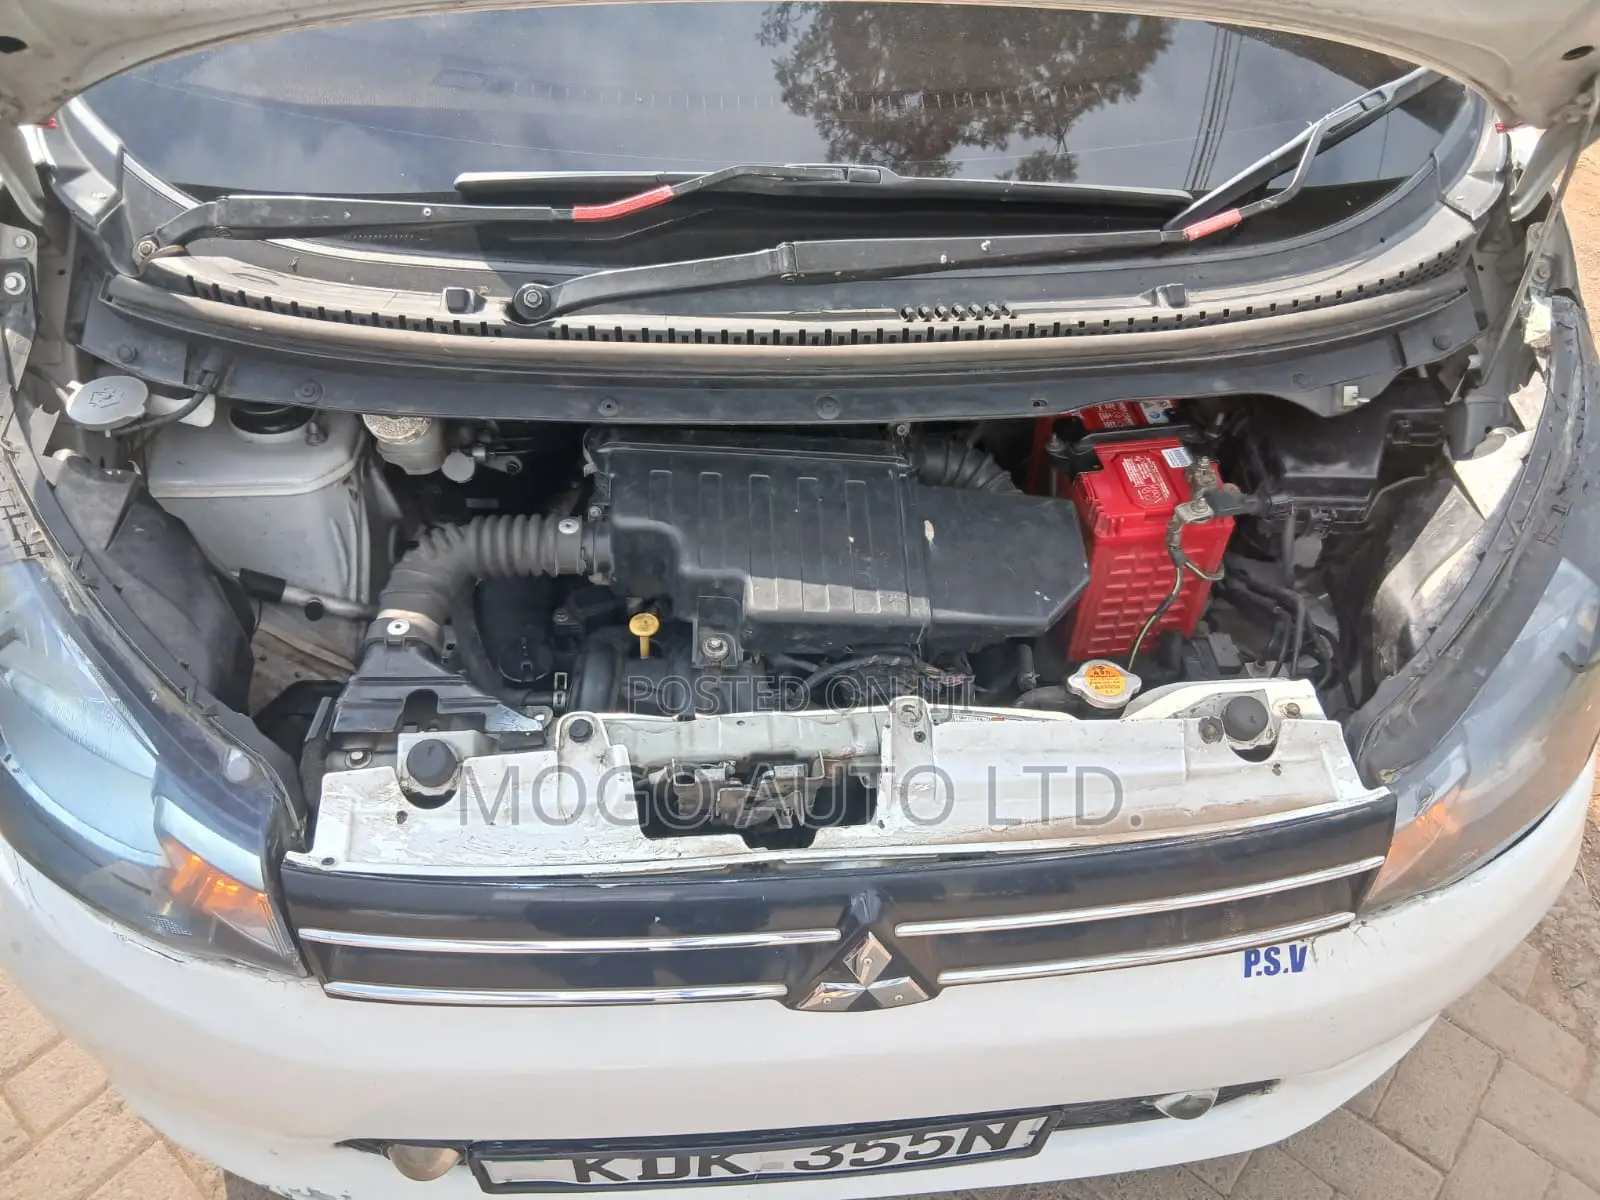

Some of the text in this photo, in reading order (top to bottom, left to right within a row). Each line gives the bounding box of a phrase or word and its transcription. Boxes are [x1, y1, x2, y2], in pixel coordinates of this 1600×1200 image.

[1243, 943, 1308, 978] P.S.V
[572, 1118, 1021, 1183] KDK 355N
